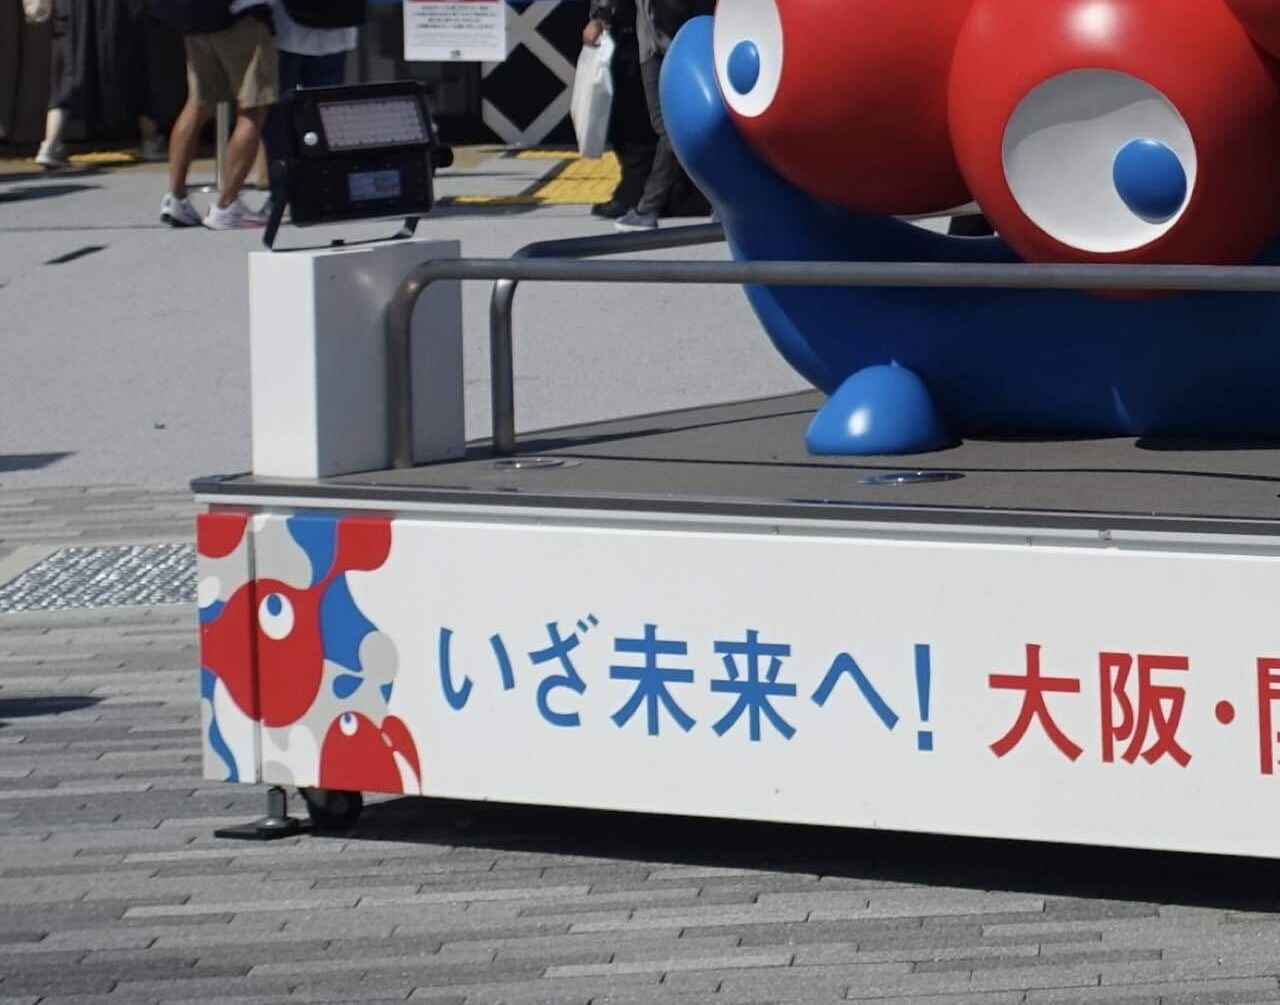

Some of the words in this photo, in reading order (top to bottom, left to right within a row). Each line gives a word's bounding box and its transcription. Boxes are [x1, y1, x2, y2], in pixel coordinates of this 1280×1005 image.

[437, 613, 935, 752] いざ未来へ!
